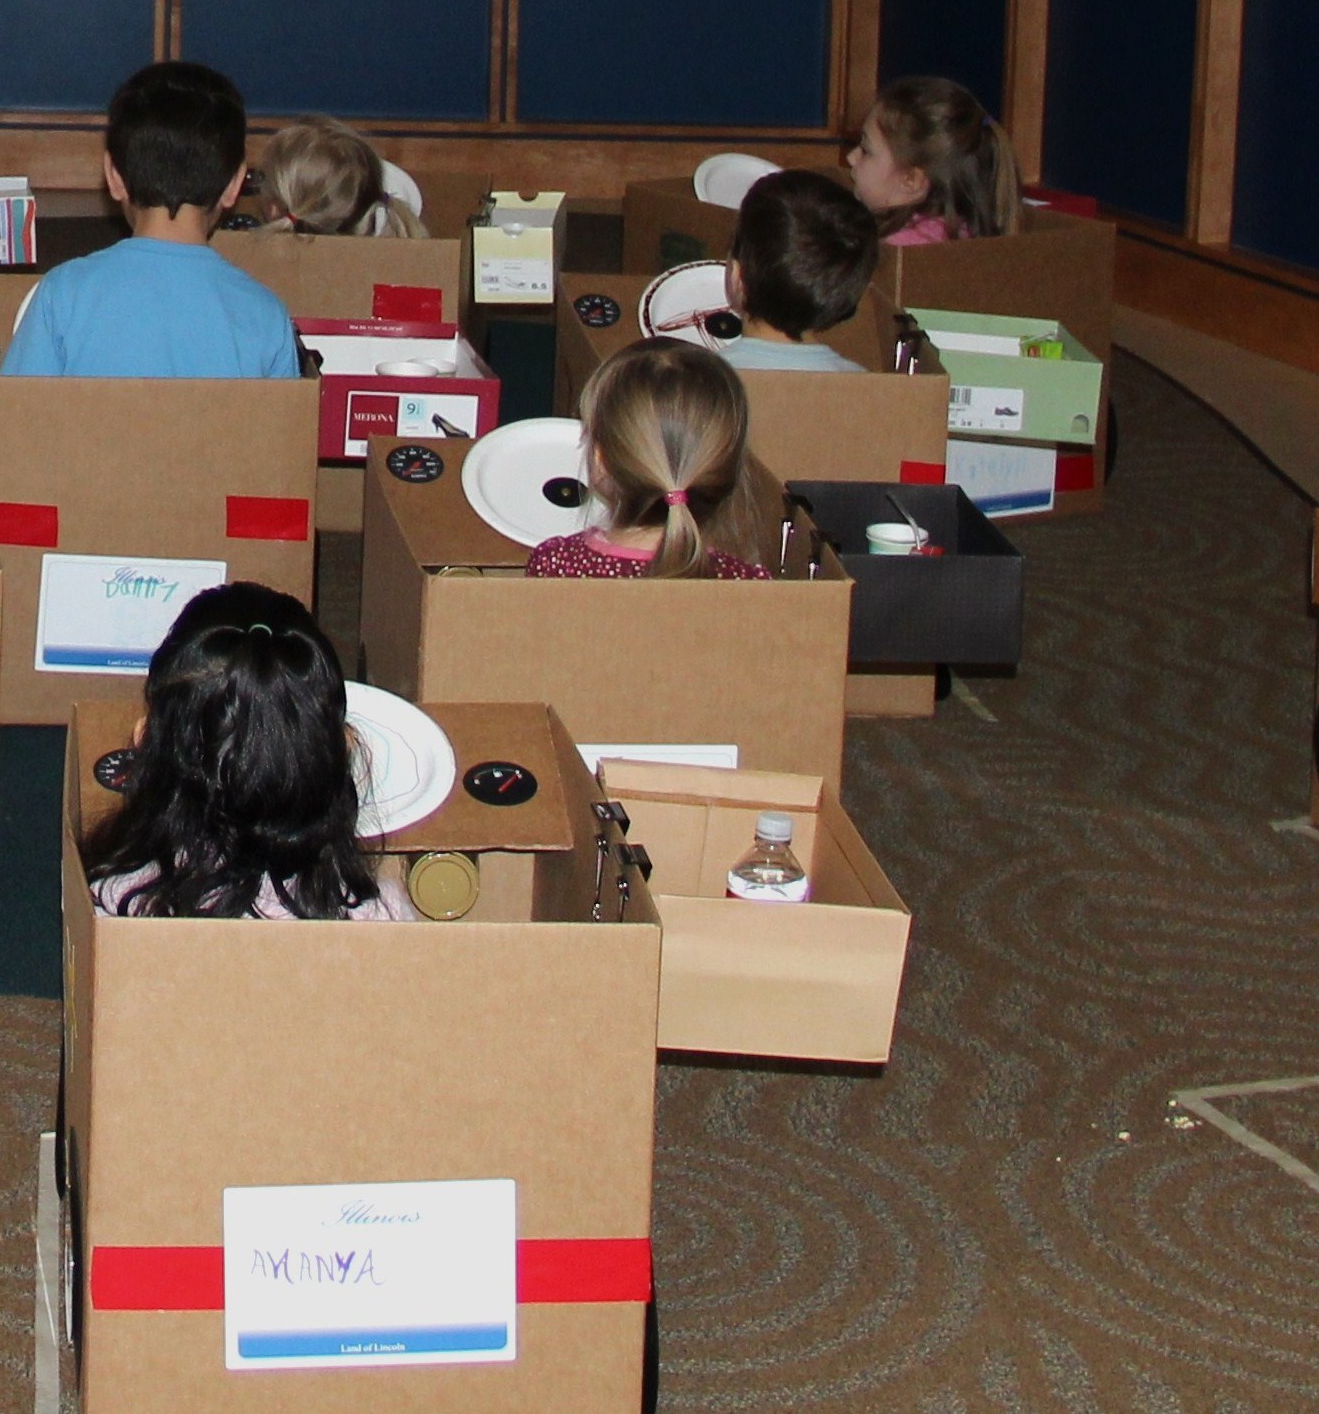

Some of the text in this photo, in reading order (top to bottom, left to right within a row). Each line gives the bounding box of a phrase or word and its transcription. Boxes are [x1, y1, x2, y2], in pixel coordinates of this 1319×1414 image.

[406, 402, 417, 415] 9
[353, 412, 395, 423] MERONA
[321, 1199, 423, 1227] Illinois
[340, 1343, 362, 1353] Land
[374, 1341, 406, 1352] Lincoln
